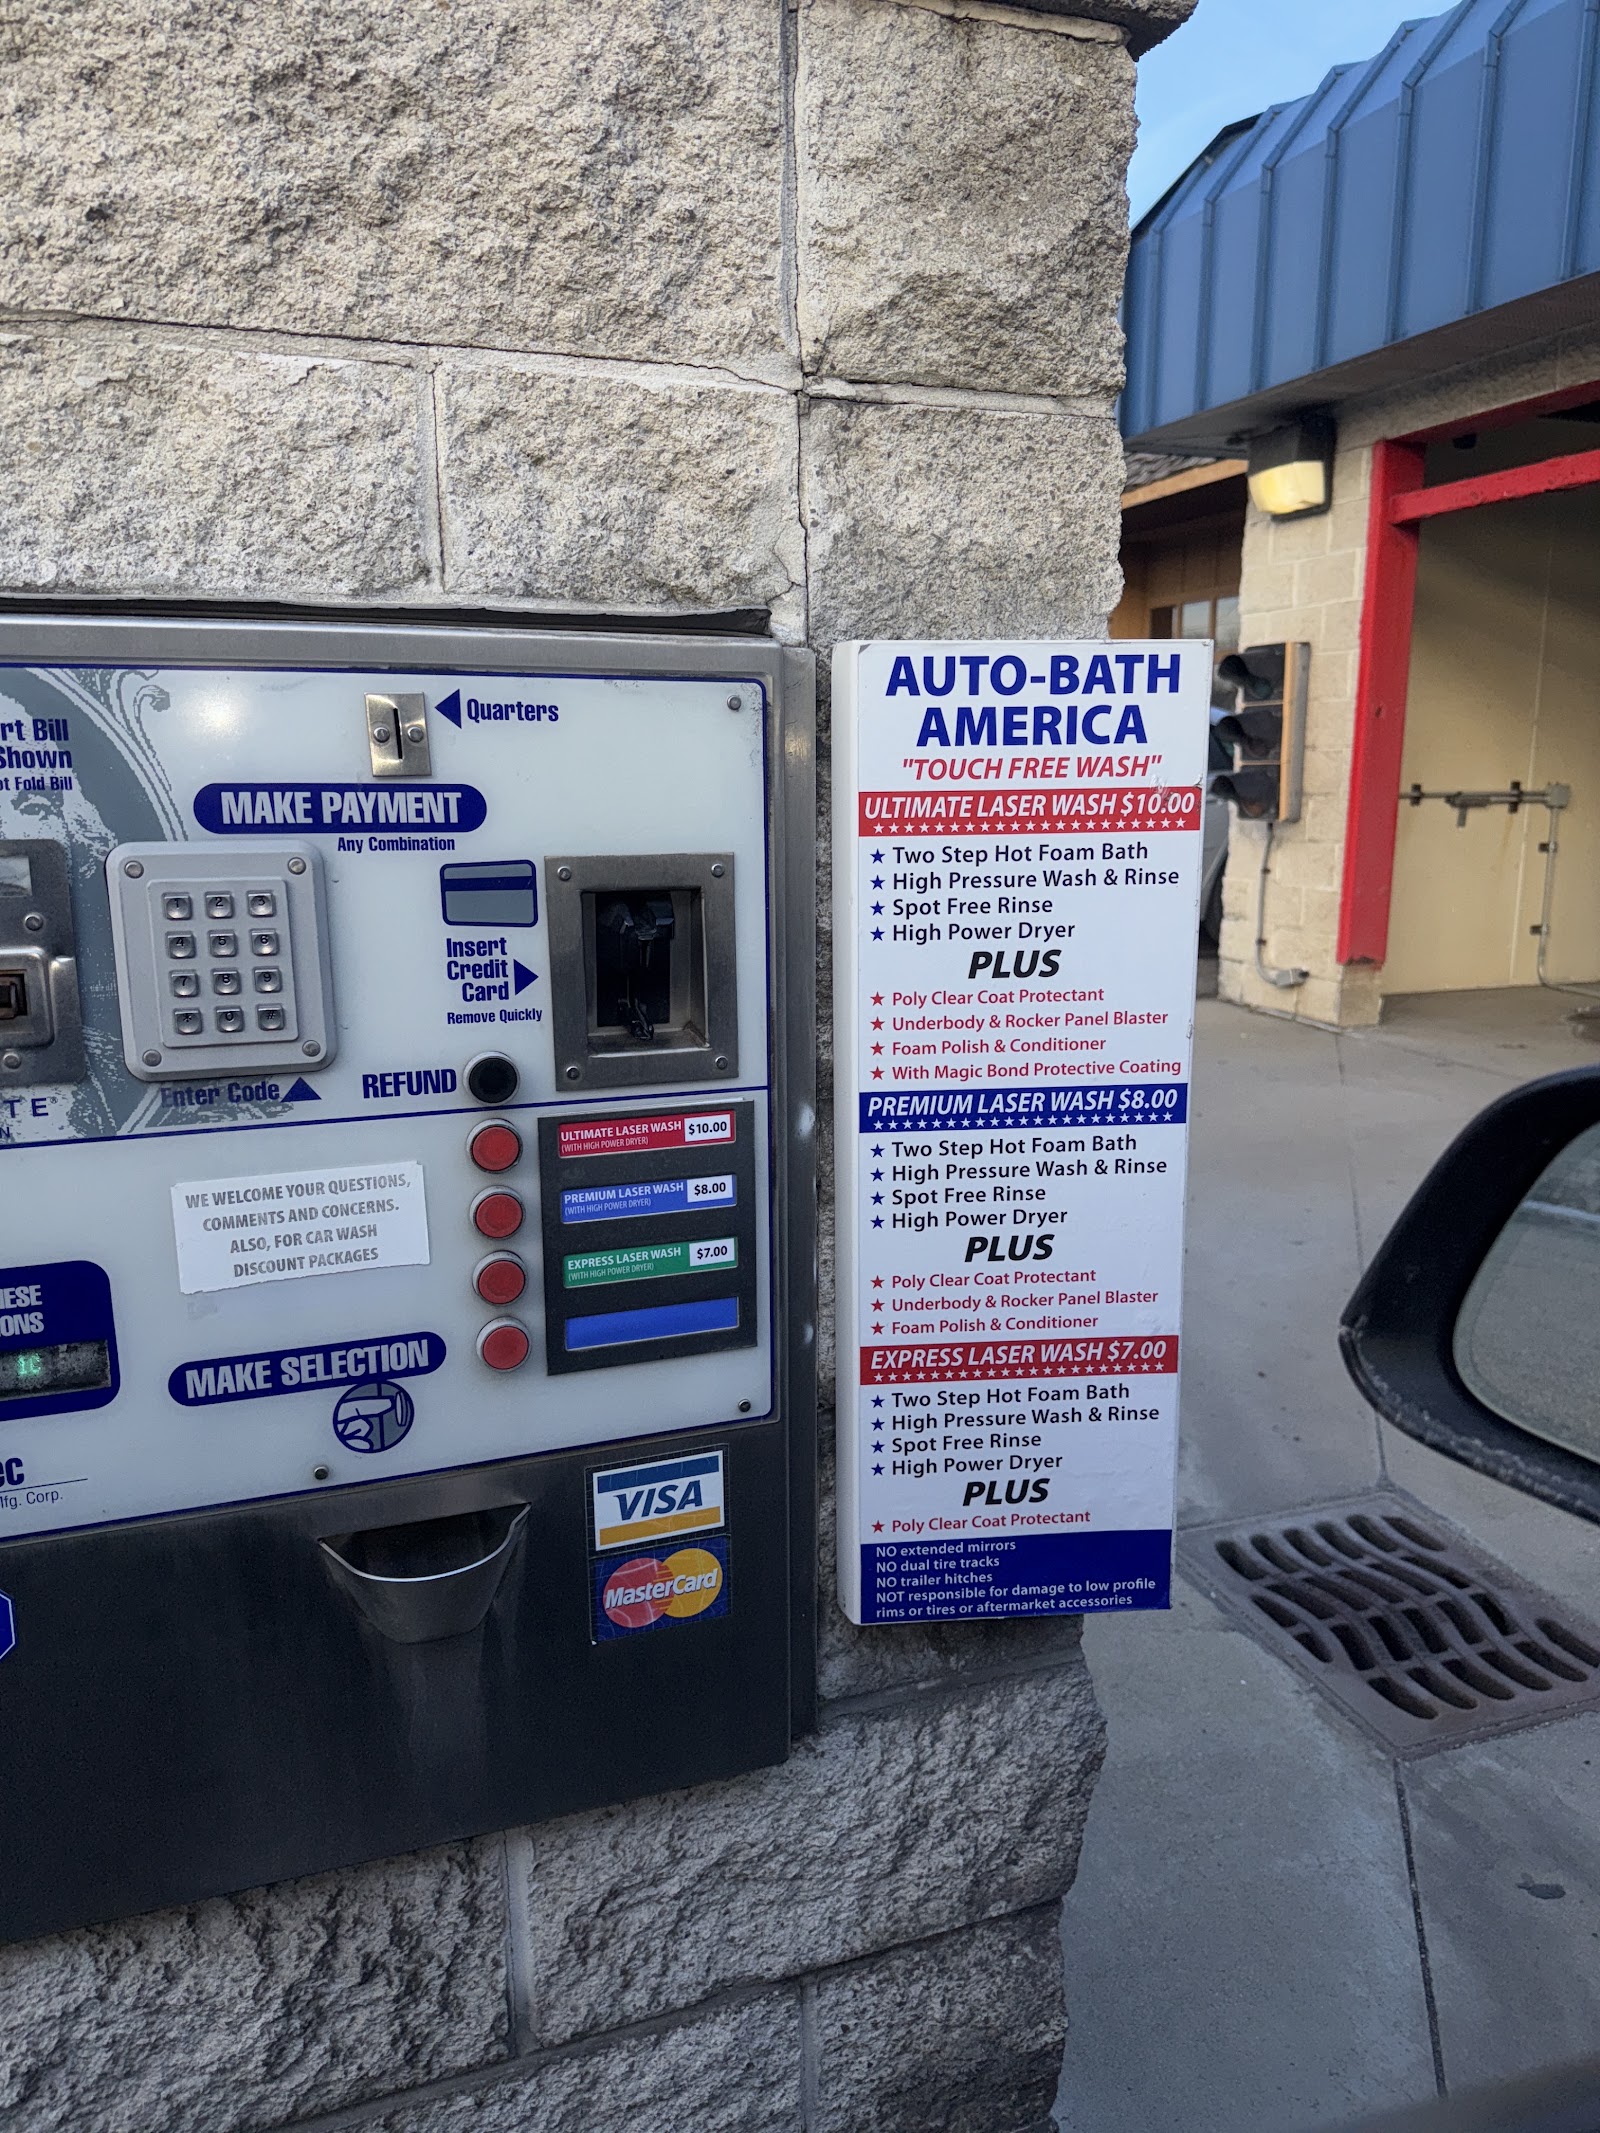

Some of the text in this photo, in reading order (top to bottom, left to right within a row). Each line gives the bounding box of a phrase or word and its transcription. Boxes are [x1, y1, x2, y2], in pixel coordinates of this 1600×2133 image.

[886, 654, 1180, 696] AUTO-BATH
[467, 699, 558, 723] Quarters
[33, 718, 69, 741] Bill
[917, 705, 1147, 746] AMERICA
[903, 755, 1162, 780] "TOUCH FREE WASH"
[15, 777, 45, 790] Fold
[50, 776, 72, 790] Bill
[221, 792, 461, 824] MAKE PAYMENT
[865, 789, 1194, 819] ULTIMATE LASER WASH $10.00
[338, 837, 455, 853] Any Combination
[893, 842, 1147, 866] Two Step Hot Foam Bath
[894, 868, 1179, 894] High Pressure Wash & Rinse
[894, 897, 1052, 919] Spot Free Rinse
[894, 922, 1075, 945] High Power Dryer
[447, 938, 507, 957] Insert
[447, 959, 508, 980] Credit
[968, 950, 1061, 979] PLUS
[462, 981, 509, 1002] Card
[893, 989, 1104, 1009] Poly Clear Coat Protectant
[447, 1008, 542, 1024] Remove Quickly
[893, 1011, 1168, 1032] Underbody & Rocker Panel Blaster
[893, 1038, 1106, 1055] Foam Polish & Conditioner
[892, 1059, 1181, 1081] With Magic Bond Protective Coating
[162, 1080, 280, 1107] Enter Code
[363, 1069, 457, 1098] REFUND
[868, 1088, 1177, 1116] PREMIUM LASER WASH $8.00
[561, 1121, 727, 1141] ULTIMATE LASER WASH $10.00
[562, 1136, 648, 1153] (WITH HIGH POWER DRYER)
[185, 1174, 410, 1208] WE WELCOME YOUR QUESTIONS,
[564, 1182, 726, 1204] PREMIUM LASER WASH $8.00
[203, 1199, 399, 1231] COMMENTS AND CONCERNS.
[230, 1224, 377, 1253] ALSO, FOR CAR WASH
[965, 1234, 1055, 1262] PLUS
[234, 1248, 378, 1277] DISCOUNT PACKAGES
[568, 1246, 728, 1270] EXPRESS LASER WASH $7.00
[870, 1339, 1168, 1371] EXPRESS LASER WASH $7.00
[185, 1340, 430, 1399] MAKE SELECTION
[892, 1383, 1129, 1408] Two Step Hot Foam Bath
[893, 1406, 1159, 1433] High Pressure Wash & Rinse
[893, 1433, 1041, 1456] Spot Free Rinse
[893, 1455, 1062, 1478] High Power Dryer
[26, 1490, 63, 1504] Corp.
[613, 1480, 703, 1521] VISA
[963, 1478, 1050, 1506] PLUS
[893, 1512, 1090, 1534] Poly Clear Coat Protectant
[877, 1541, 1016, 1557] NO extended mirrors
[877, 1556, 999, 1573] NO dual tire tracks
[605, 1567, 718, 1610] MasterCard
[877, 1572, 992, 1588] NO trailer hitches
[877, 1578, 1156, 1603] NOT responsible for damage to low profile
[877, 1595, 1132, 1617] rims or tires or aftermarket accessories
